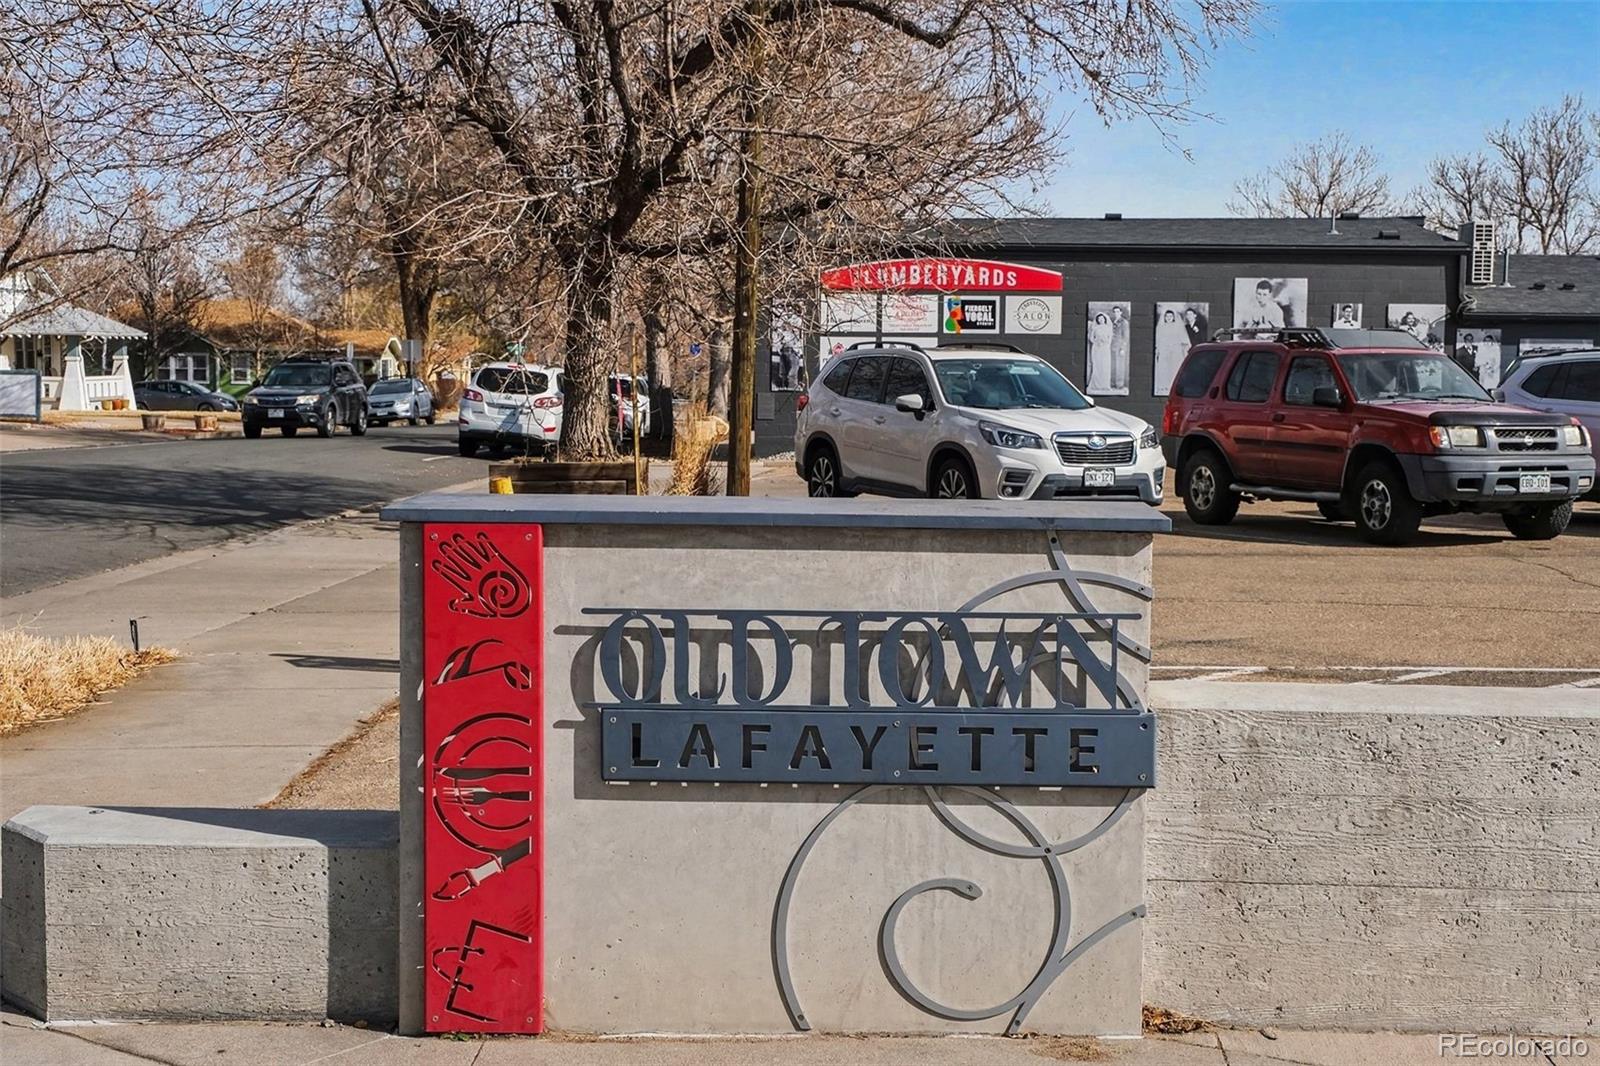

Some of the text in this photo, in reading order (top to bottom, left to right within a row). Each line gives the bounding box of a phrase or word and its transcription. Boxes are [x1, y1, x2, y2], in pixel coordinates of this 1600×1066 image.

[965, 311, 994, 322] VOCAL
[1016, 312, 1051, 320] SALON
[599, 612, 1120, 710] OLD TOWN
[631, 722, 1101, 774] LAFAYETTE
